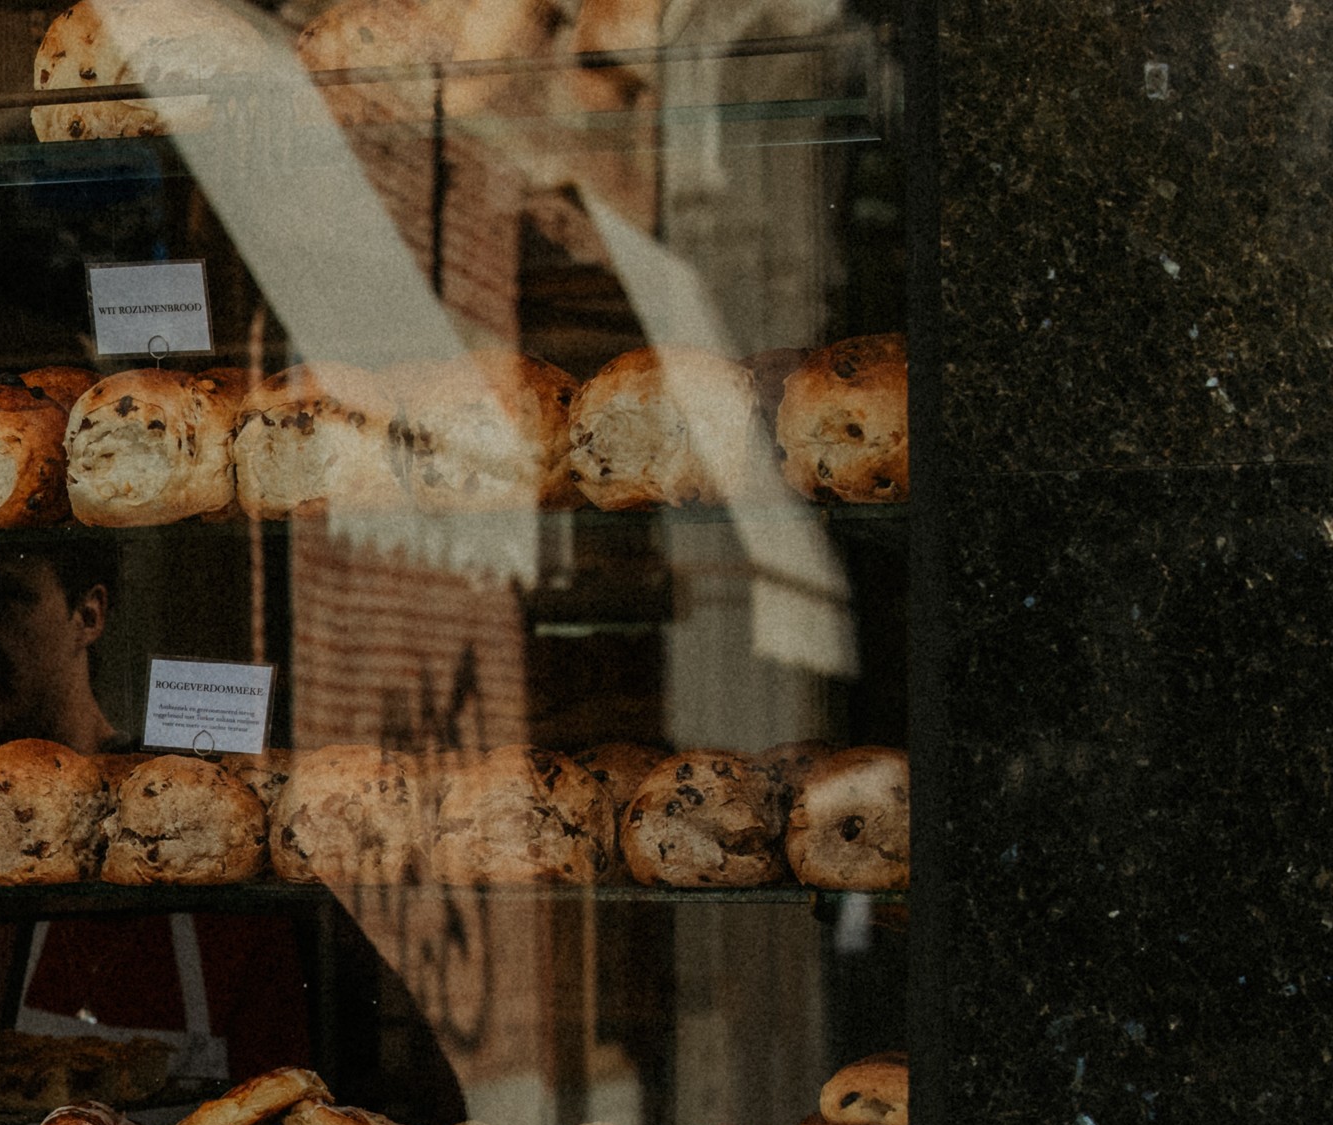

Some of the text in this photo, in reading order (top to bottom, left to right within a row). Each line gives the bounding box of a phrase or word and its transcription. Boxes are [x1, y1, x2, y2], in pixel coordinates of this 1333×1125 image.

[98, 303, 202, 315] WIT ROZIJNENBROOD
[155, 680, 264, 696] ROGGEVERDOMMEKE
